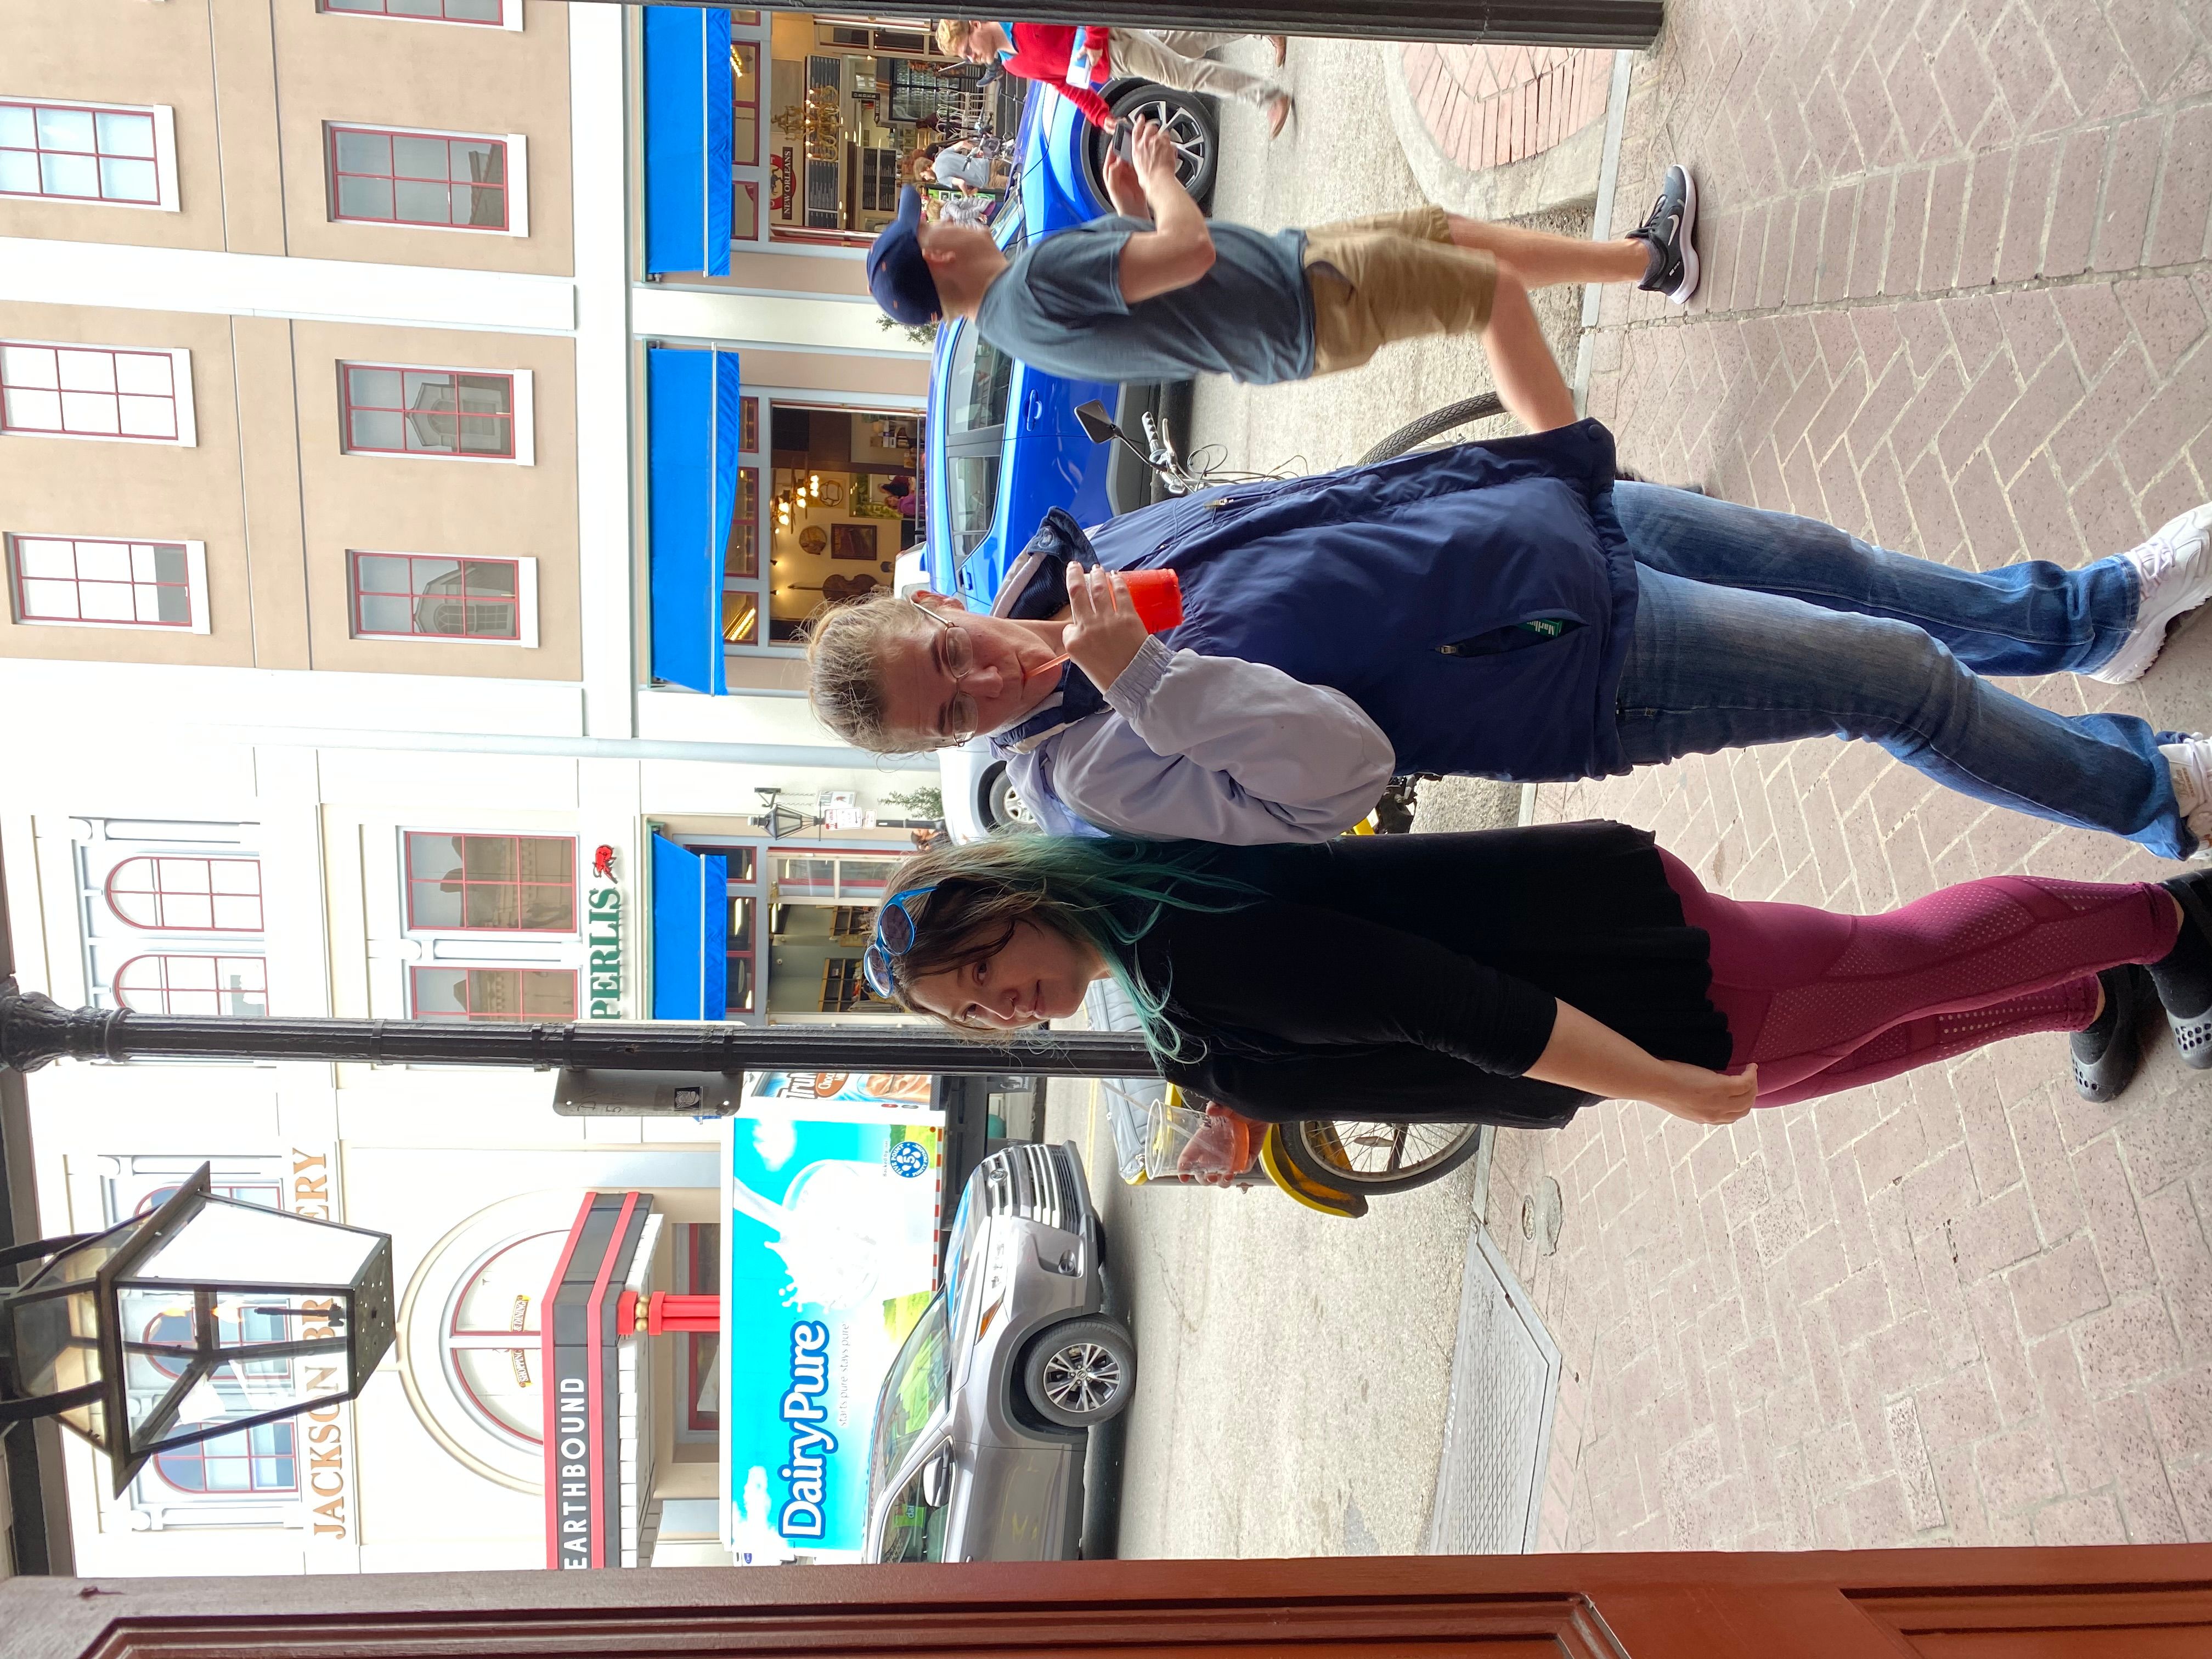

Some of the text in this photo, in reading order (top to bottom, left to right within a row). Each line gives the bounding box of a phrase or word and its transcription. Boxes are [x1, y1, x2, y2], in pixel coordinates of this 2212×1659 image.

[589, 888, 622, 1019] PERLIS
[890, 1143, 904, 1175] FIVE POINT
[903, 1155, 916, 1164] 5
[514, 1300, 526, 1324] DINING
[292, 1147, 346, 1540] JACKSON BRERY
[841, 1323, 850, 1346] pure
[514, 1350, 529, 1383] SHOPPING
[839, 1349, 849, 1372] stays
[838, 1401, 848, 1426] starts
[779, 1323, 837, 1537] DairyPure
[560, 1378, 588, 1570] EARTHBOUND
